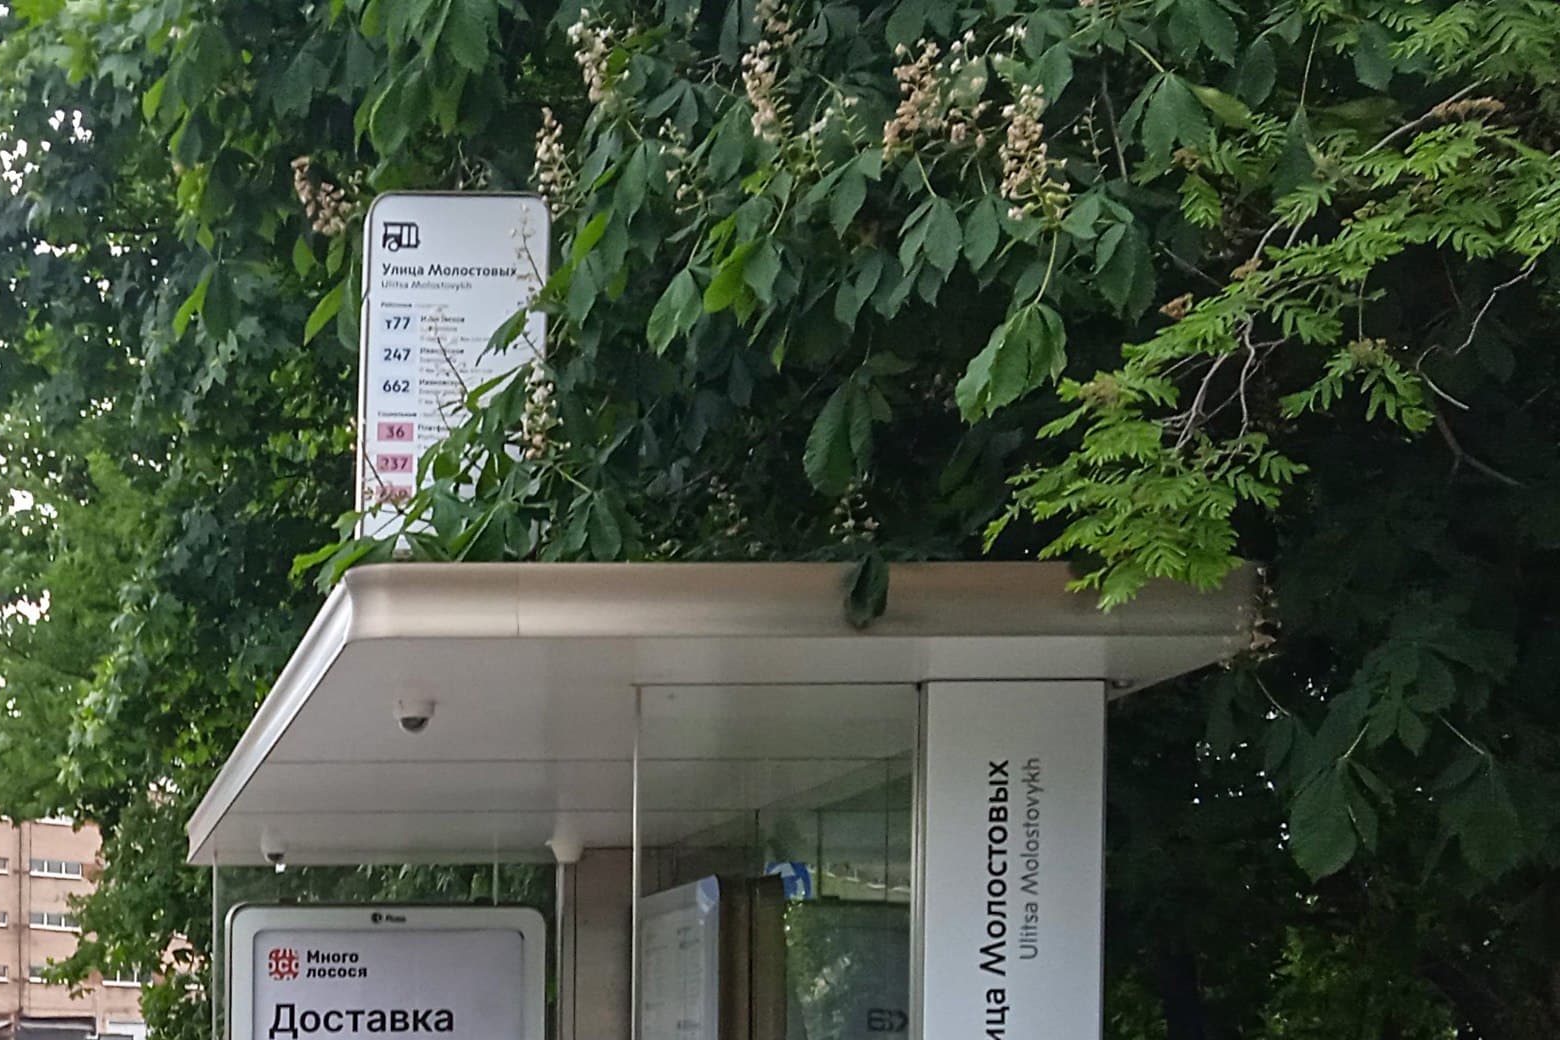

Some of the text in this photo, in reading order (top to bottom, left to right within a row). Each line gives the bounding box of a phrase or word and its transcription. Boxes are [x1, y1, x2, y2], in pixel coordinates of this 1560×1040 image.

[382, 264, 517, 277] Улица Молостовых
[384, 348, 411, 361] 247
[383, 380, 410, 393] 662
[386, 426, 405, 439] 36
[1019, 757, 1045, 960] Ulitsa Molostovykh
[980, 758, 1010, 975] Молостовых
[307, 950, 359, 964] Много
[306, 966, 368, 978] лосося
[269, 1003, 454, 1040] Доставка
